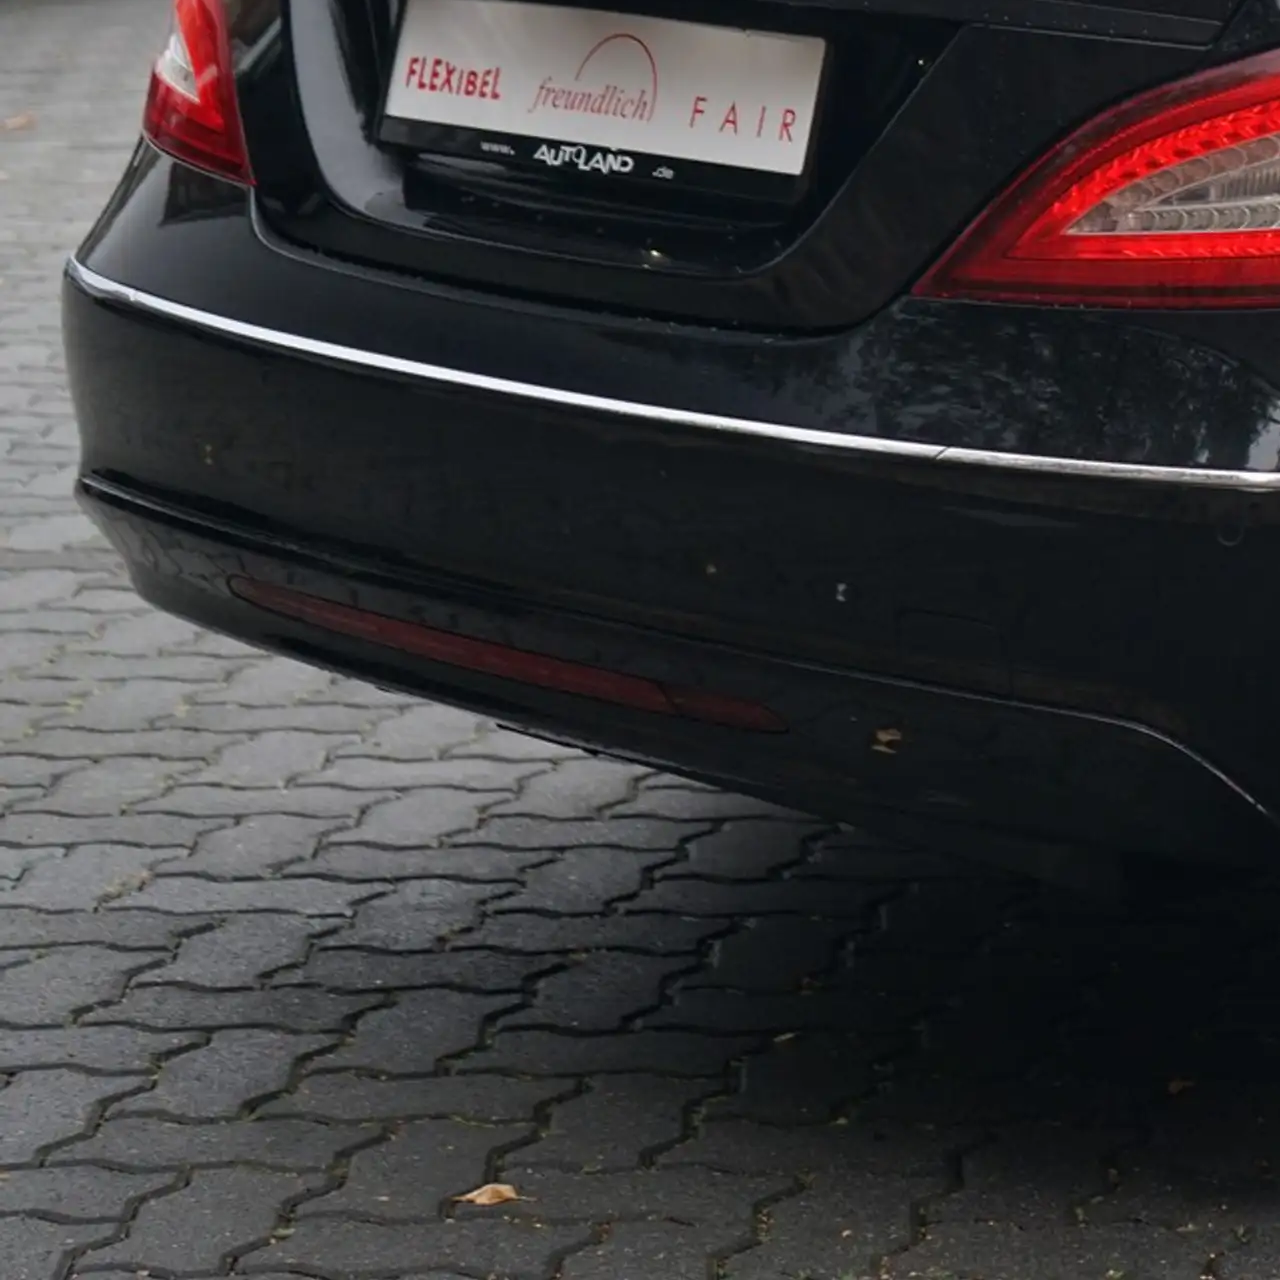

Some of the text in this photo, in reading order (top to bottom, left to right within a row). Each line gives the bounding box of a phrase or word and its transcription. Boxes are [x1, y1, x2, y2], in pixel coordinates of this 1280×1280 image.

[405, 56, 797, 142] FLEXIBEL freundlich FAIR
[480, 141, 516, 156] www.
[533, 144, 635, 175] AUTOLAND
